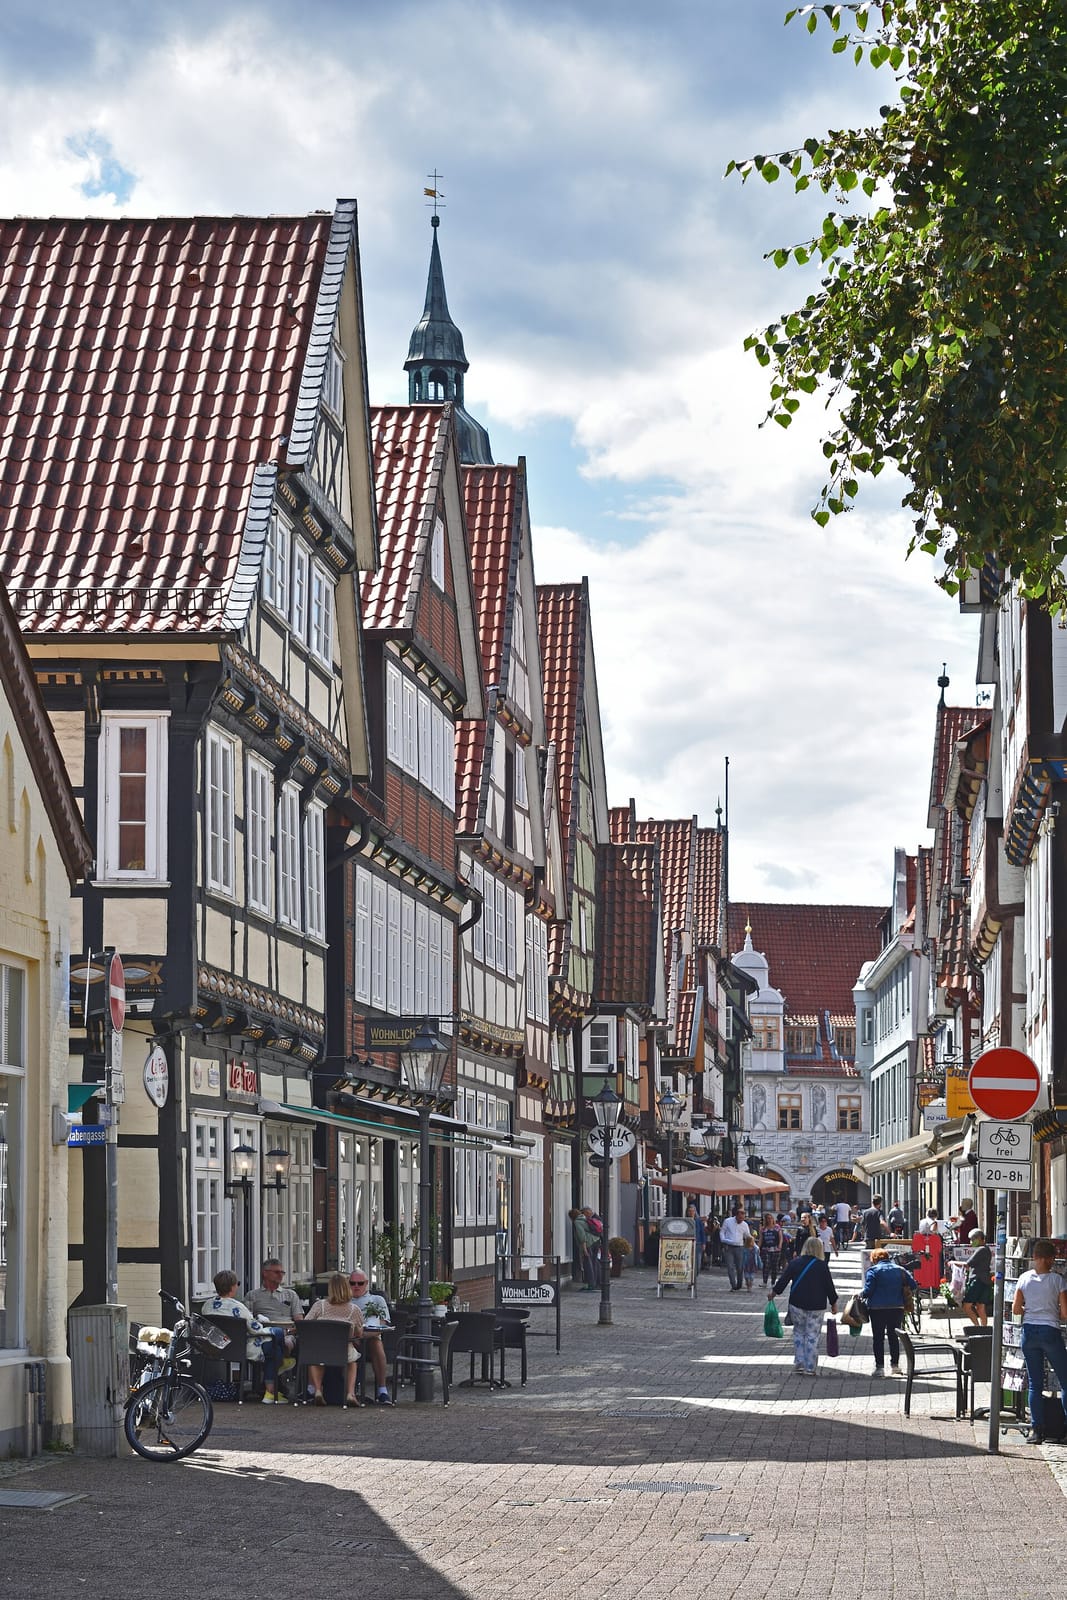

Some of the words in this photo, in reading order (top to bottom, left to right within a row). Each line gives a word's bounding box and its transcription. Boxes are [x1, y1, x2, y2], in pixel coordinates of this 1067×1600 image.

[370, 1026, 416, 1039] WOHNLICH
[590, 1127, 632, 1144] ANTIK
[996, 1147, 1013, 1157] frei
[986, 1169, 1023, 1182] 20-8h
